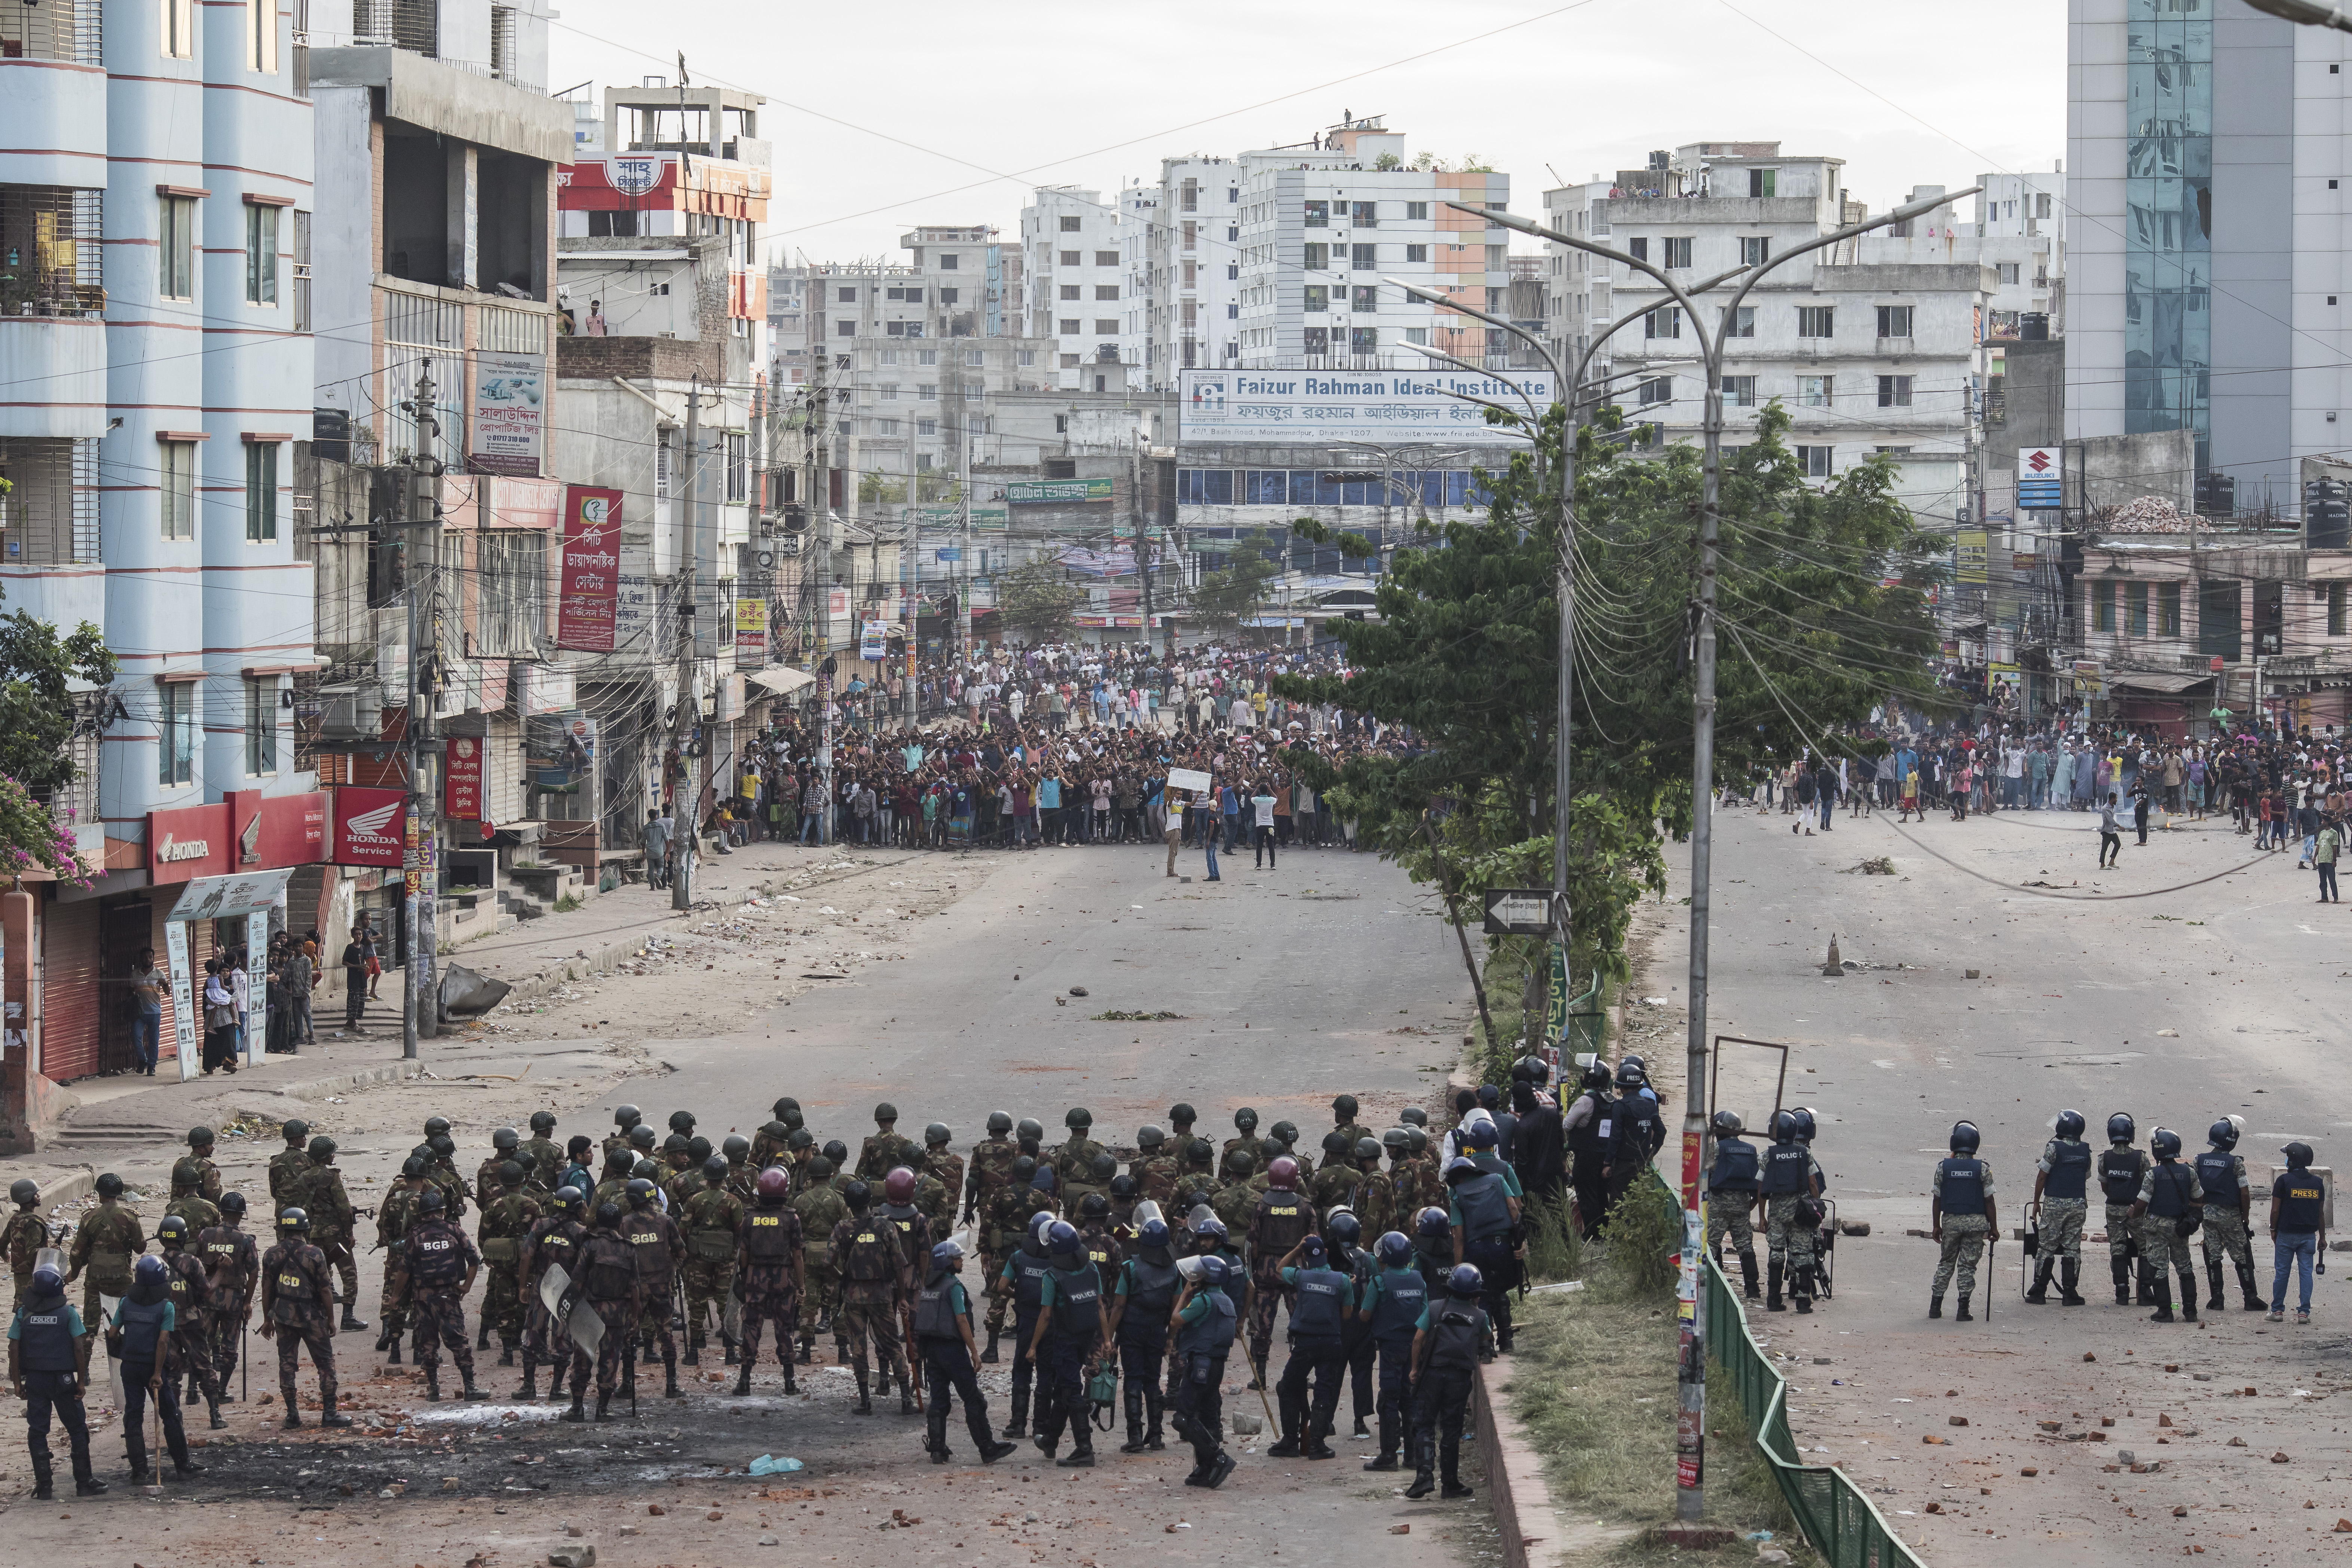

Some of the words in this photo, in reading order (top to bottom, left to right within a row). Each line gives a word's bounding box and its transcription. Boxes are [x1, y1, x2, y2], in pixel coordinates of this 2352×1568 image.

[617, 176, 651, 186] সিমেন্ট
[1238, 377, 1296, 394] Faizur
[1305, 378, 1385, 395] Rahman
[1394, 379, 1441, 395] Ideal
[1450, 379, 1545, 395] Institute
[479, 405, 540, 423] সালাউদ্দিন
[1237, 405, 1293, 421] ফয়জুর
[1301, 407, 1355, 420] রহমান
[1364, 404, 1440, 421] আইডিয়াল
[480, 423, 522, 433] প্রোপার্টিজ
[524, 424, 539, 435] লিঃ
[1260, 429, 1314, 438] Mohammadpur,
[498, 481, 509, 508] CITY
[510, 481, 539, 509] DIAGNOSTIC
[539, 482, 558, 509] CENTER
[1010, 483, 1042, 499] হোটেল
[1045, 484, 1088, 497] শুভেচ্ছা
[1088, 483, 1111, 495] আবাসিক
[584, 528, 602, 547] সিটি
[567, 550, 616, 570] ডায়াগনষ্টিক
[576, 572, 604, 591] সেন্টার
[570, 596, 585, 605] সিটি
[629, 591, 643, 604] ফ্রিজ
[566, 606, 597, 617] সার্ভিসেস
[738, 636, 749, 644] সিটি
[452, 760, 462, 769] সিটি
[456, 785, 472, 795] ডেন্টাল
[456, 798, 471, 808] ক্লিনিক
[313, 813, 323, 821] Motors
[346, 834, 399, 844] HONDA
[172, 840, 209, 860] HONDA
[352, 846, 392, 855] Service
[242, 853, 261, 863] HONDA
[1271, 1206, 1297, 1215] BGB
[753, 1216, 779, 1226] BGB
[631, 1232, 658, 1243] BGB
[208, 1243, 234, 1253] BGB
[423, 1240, 449, 1251] BGB
[1071, 1290, 1097, 1301] POLICE
